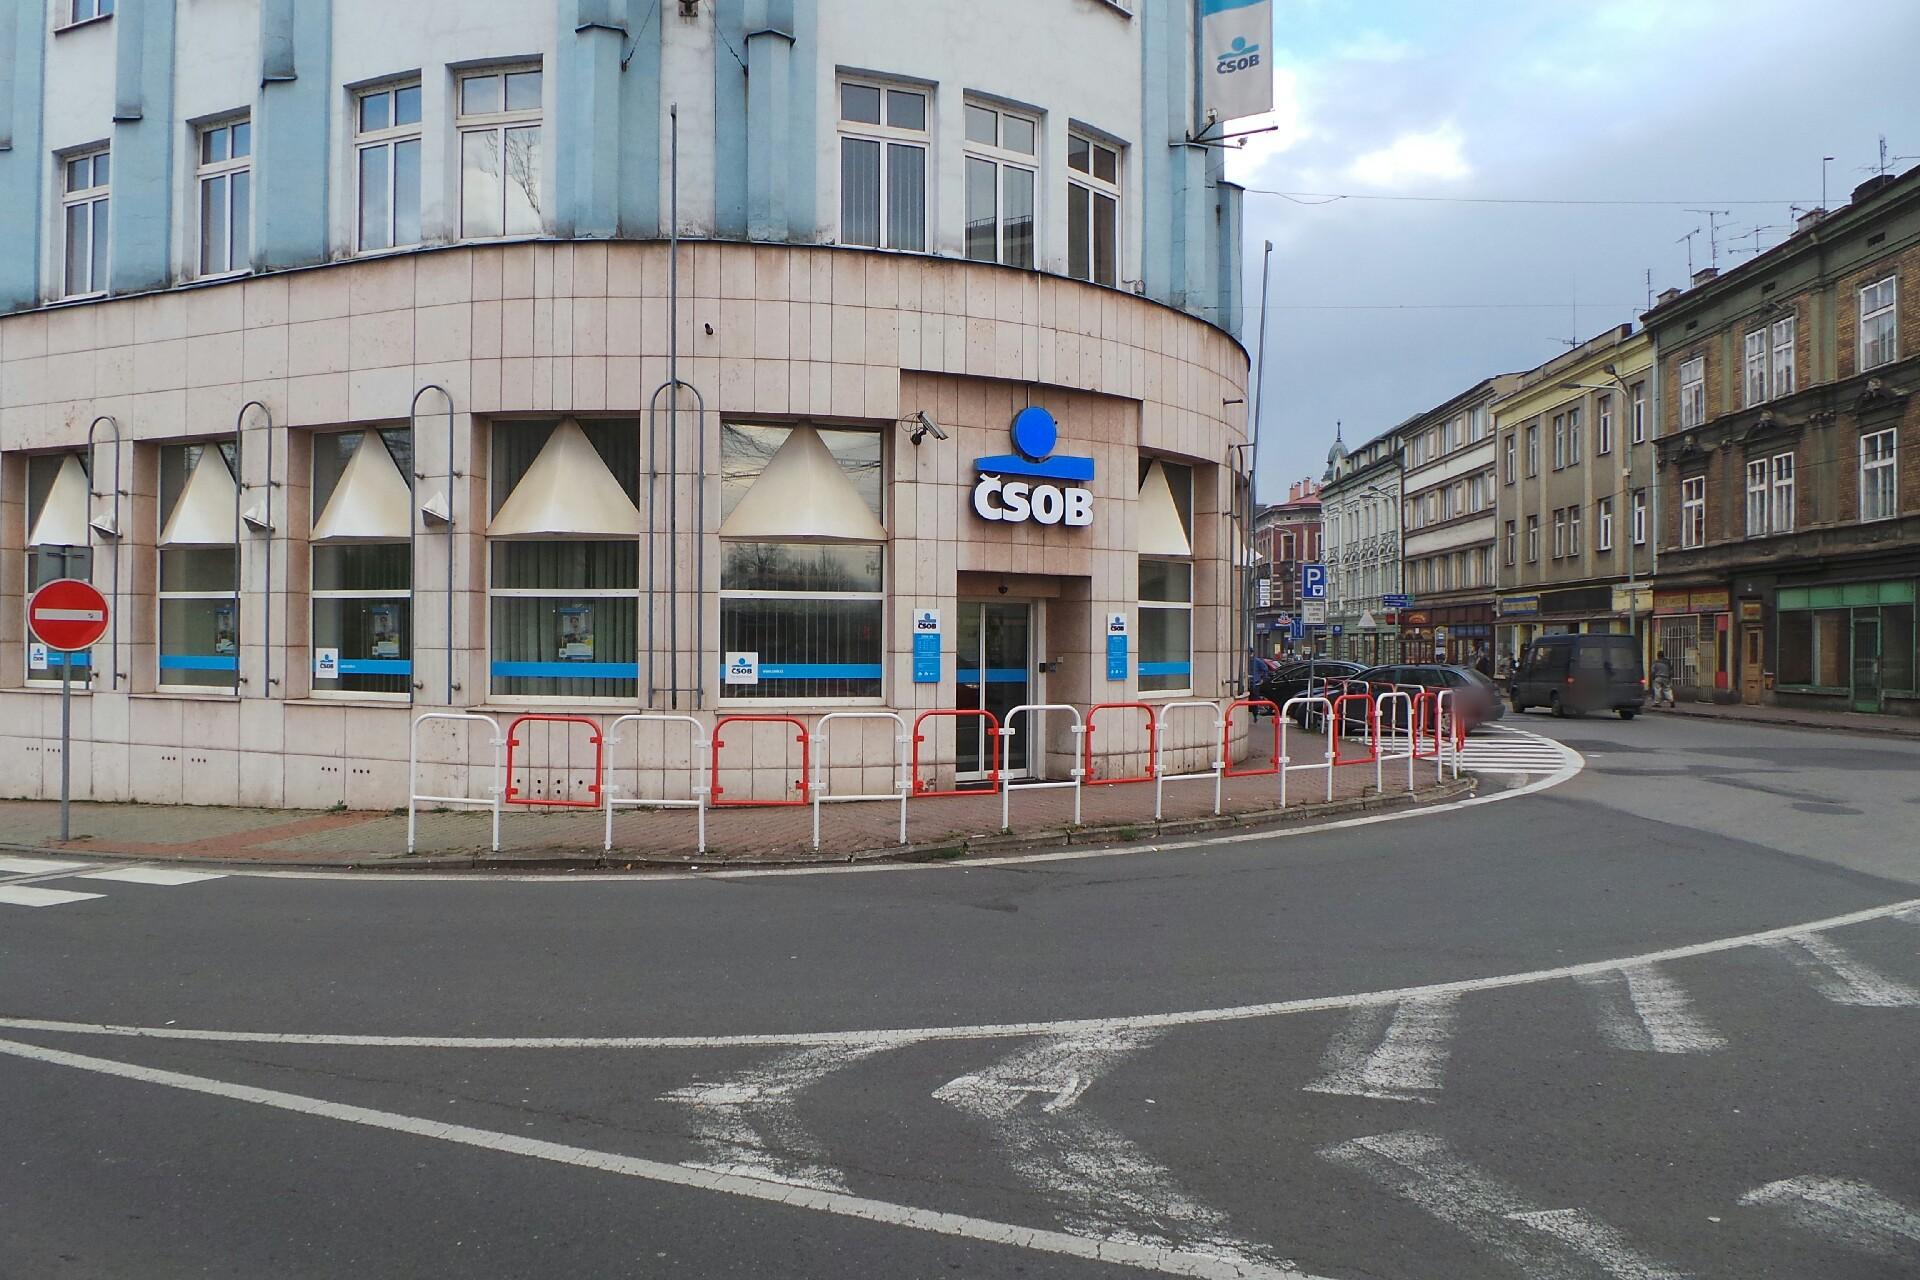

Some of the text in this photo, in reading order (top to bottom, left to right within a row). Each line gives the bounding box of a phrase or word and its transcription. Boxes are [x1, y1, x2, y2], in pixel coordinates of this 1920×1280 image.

[1216, 54, 1260, 74] ČSOB
[974, 472, 1094, 526] ČSOB
[1307, 568, 1321, 589] P
